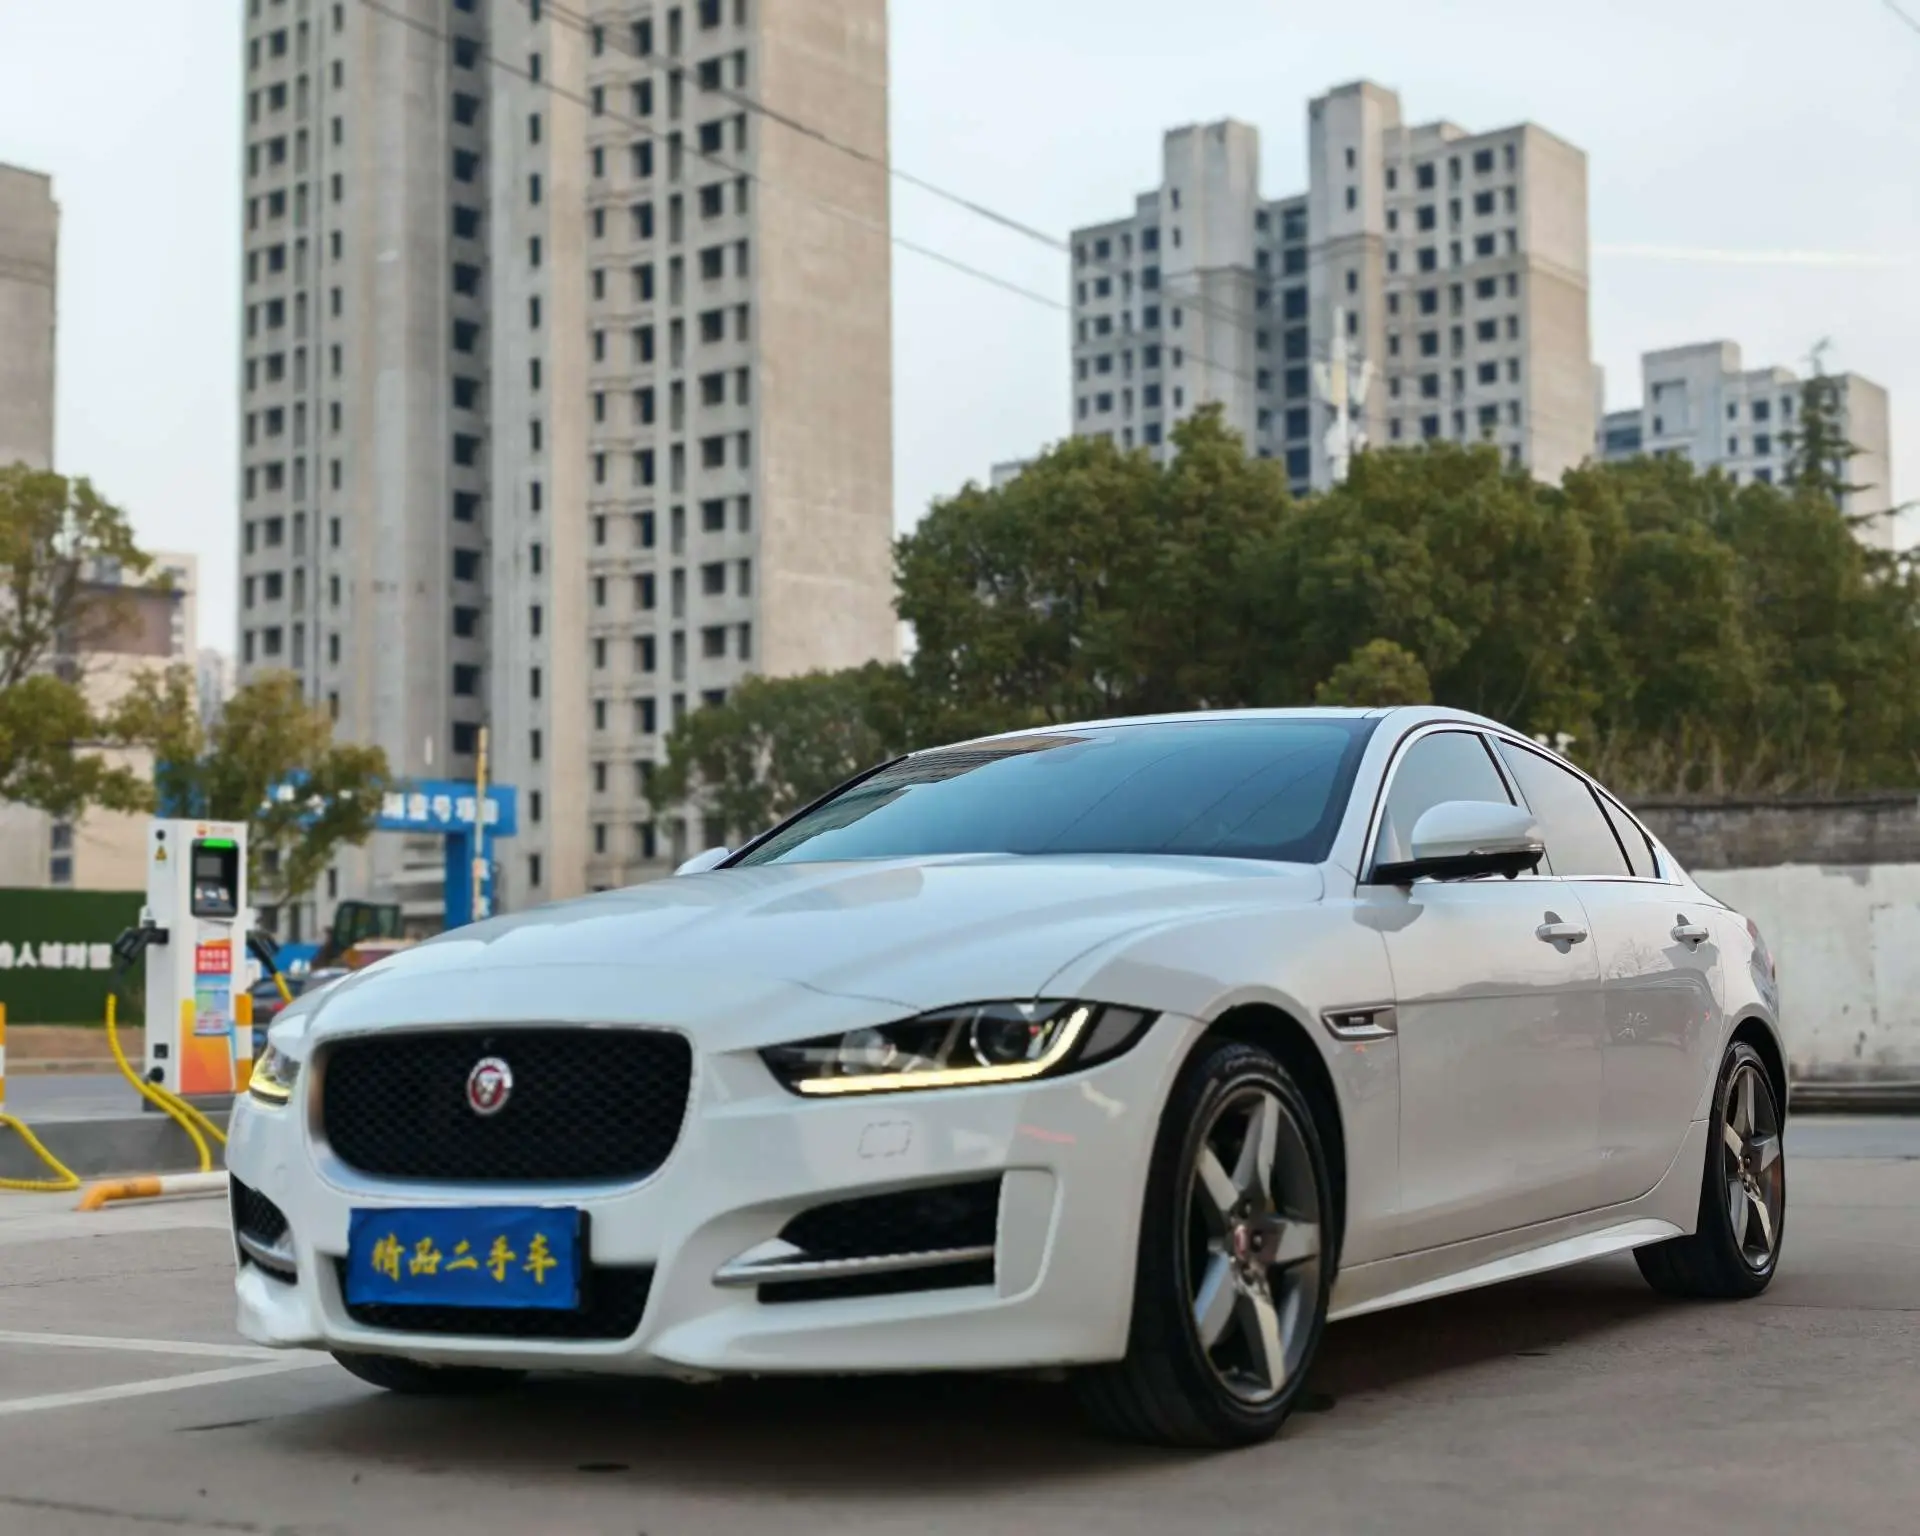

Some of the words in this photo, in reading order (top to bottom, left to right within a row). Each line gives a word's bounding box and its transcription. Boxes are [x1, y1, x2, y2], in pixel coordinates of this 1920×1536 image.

[372, 1233, 557, 1283] 精品二手车
